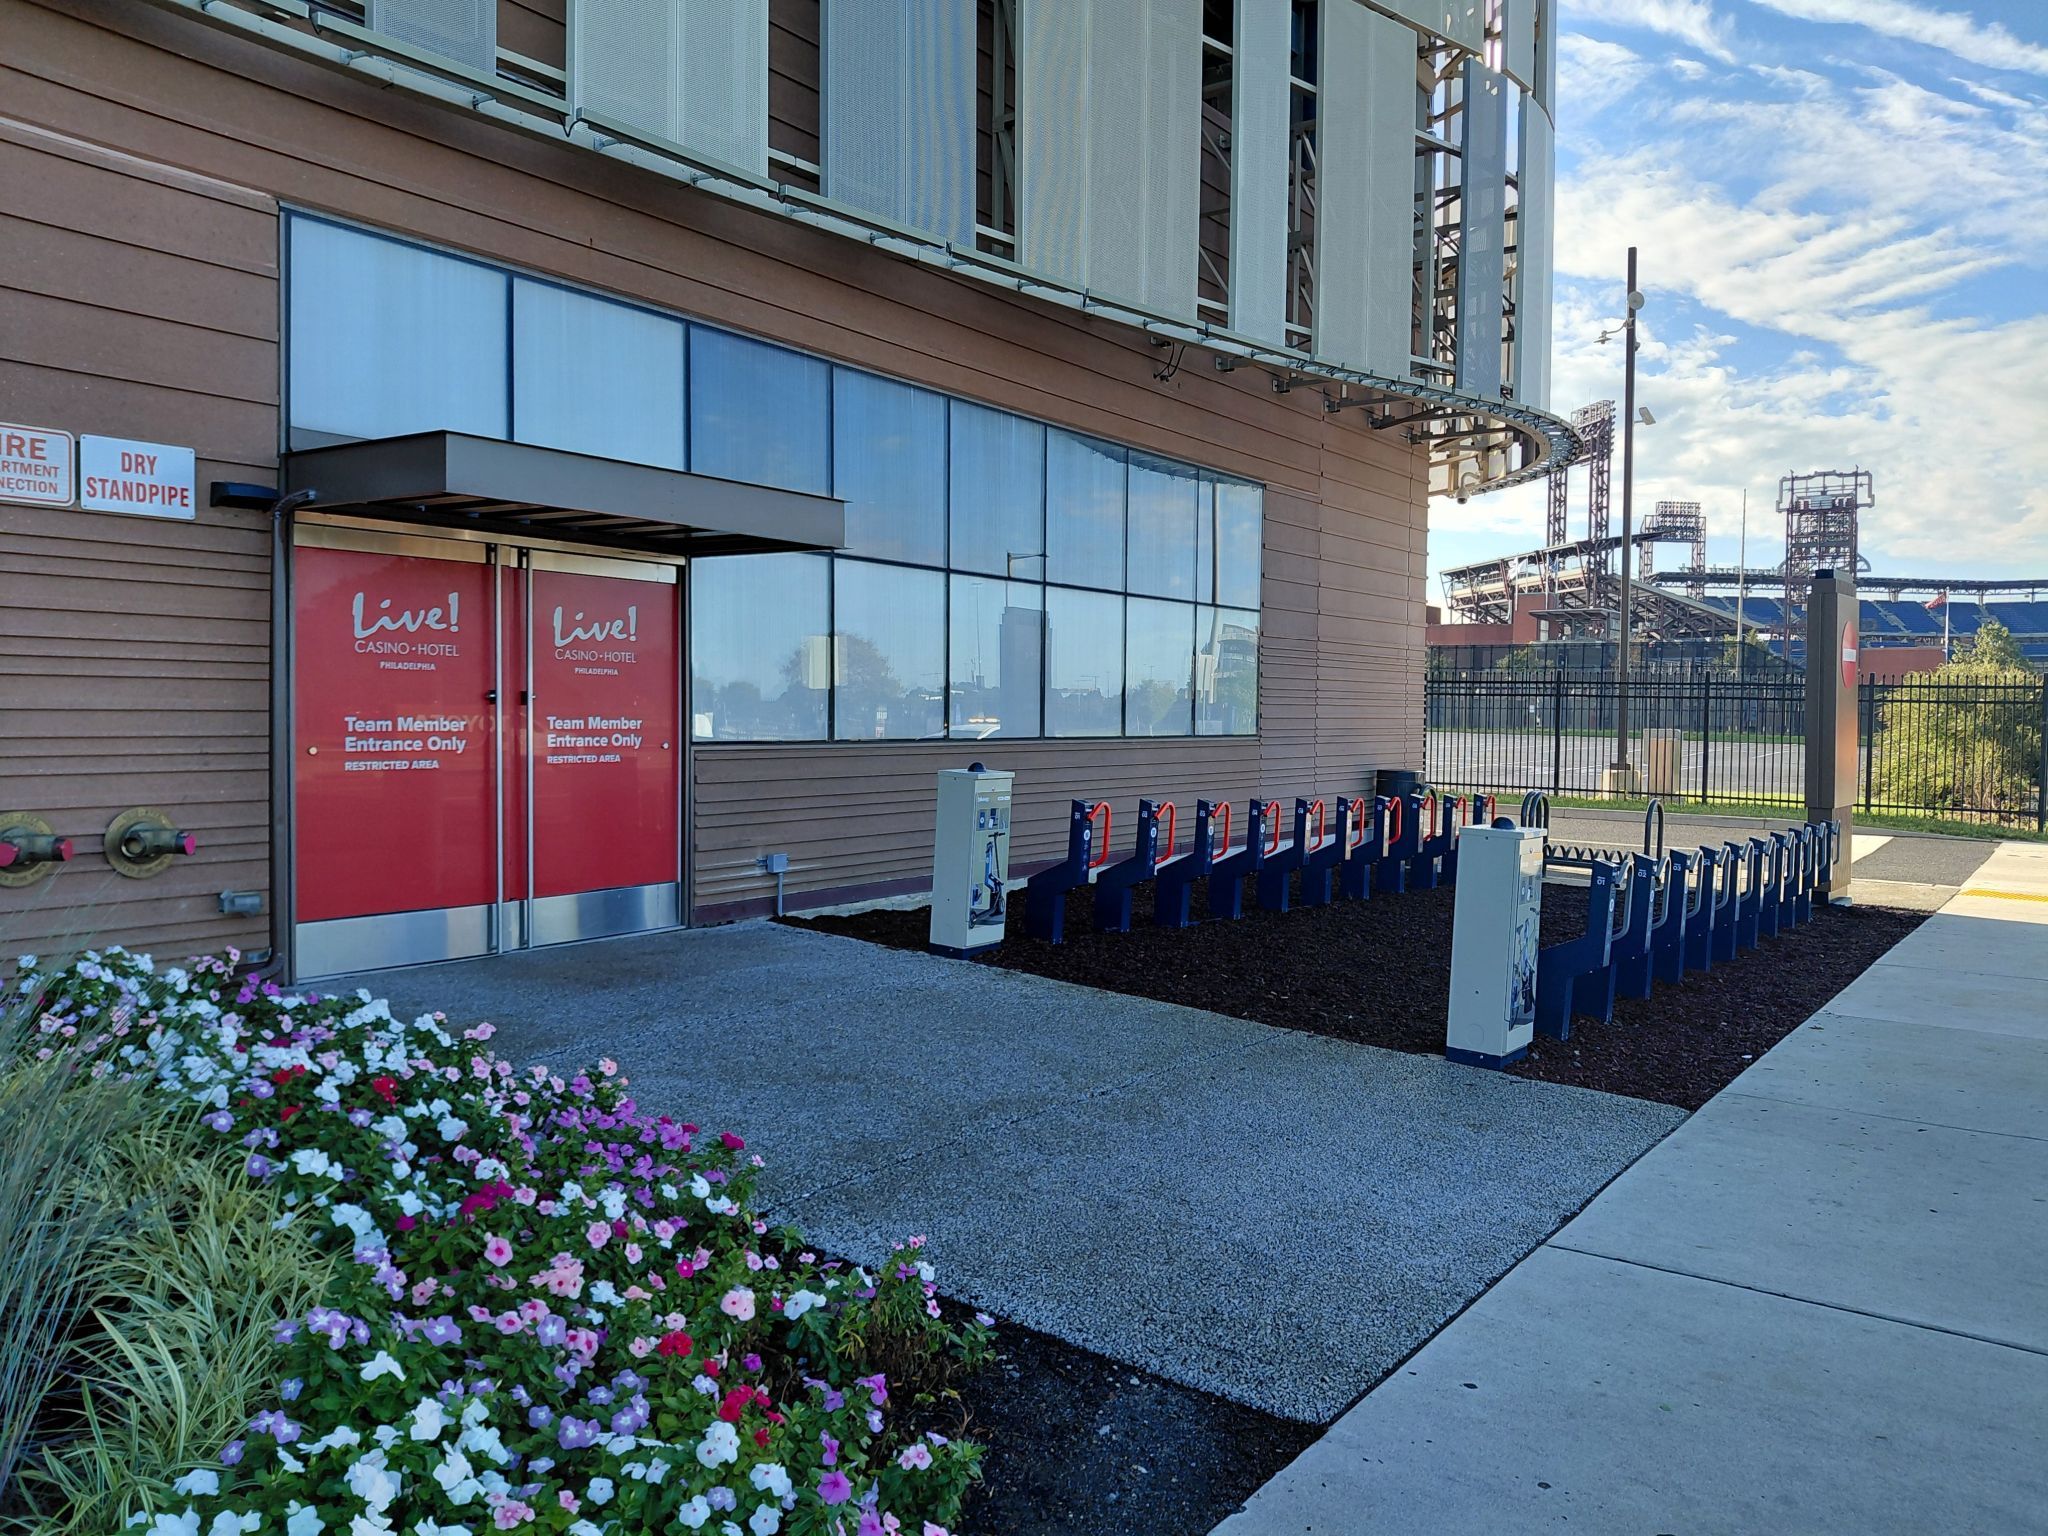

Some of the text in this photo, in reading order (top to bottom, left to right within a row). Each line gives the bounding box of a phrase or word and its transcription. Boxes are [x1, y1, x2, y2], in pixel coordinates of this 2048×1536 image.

[0, 431, 47, 461] RE
[121, 452, 157, 475] DRY
[86, 477, 189, 507] STANDPIPE
[352, 591, 459, 639] Live!
[553, 606, 637, 648] Live!
[354, 640, 460, 657] CASINO HOTEL
[555, 649, 637, 664] CASINO HOTEL
[380, 661, 436, 671] PHILADELPHIA
[575, 667, 619, 676] PHILADELPHIA
[344, 716, 393, 732] Team
[397, 716, 467, 732] Member
[546, 716, 643, 730] Team Member
[344, 736, 467, 754] Entrance Only
[547, 734, 643, 750] Entrance Only
[344, 760, 440, 771] RESTRICTED AREA
[547, 754, 621, 764] RESTRICTED AREA
